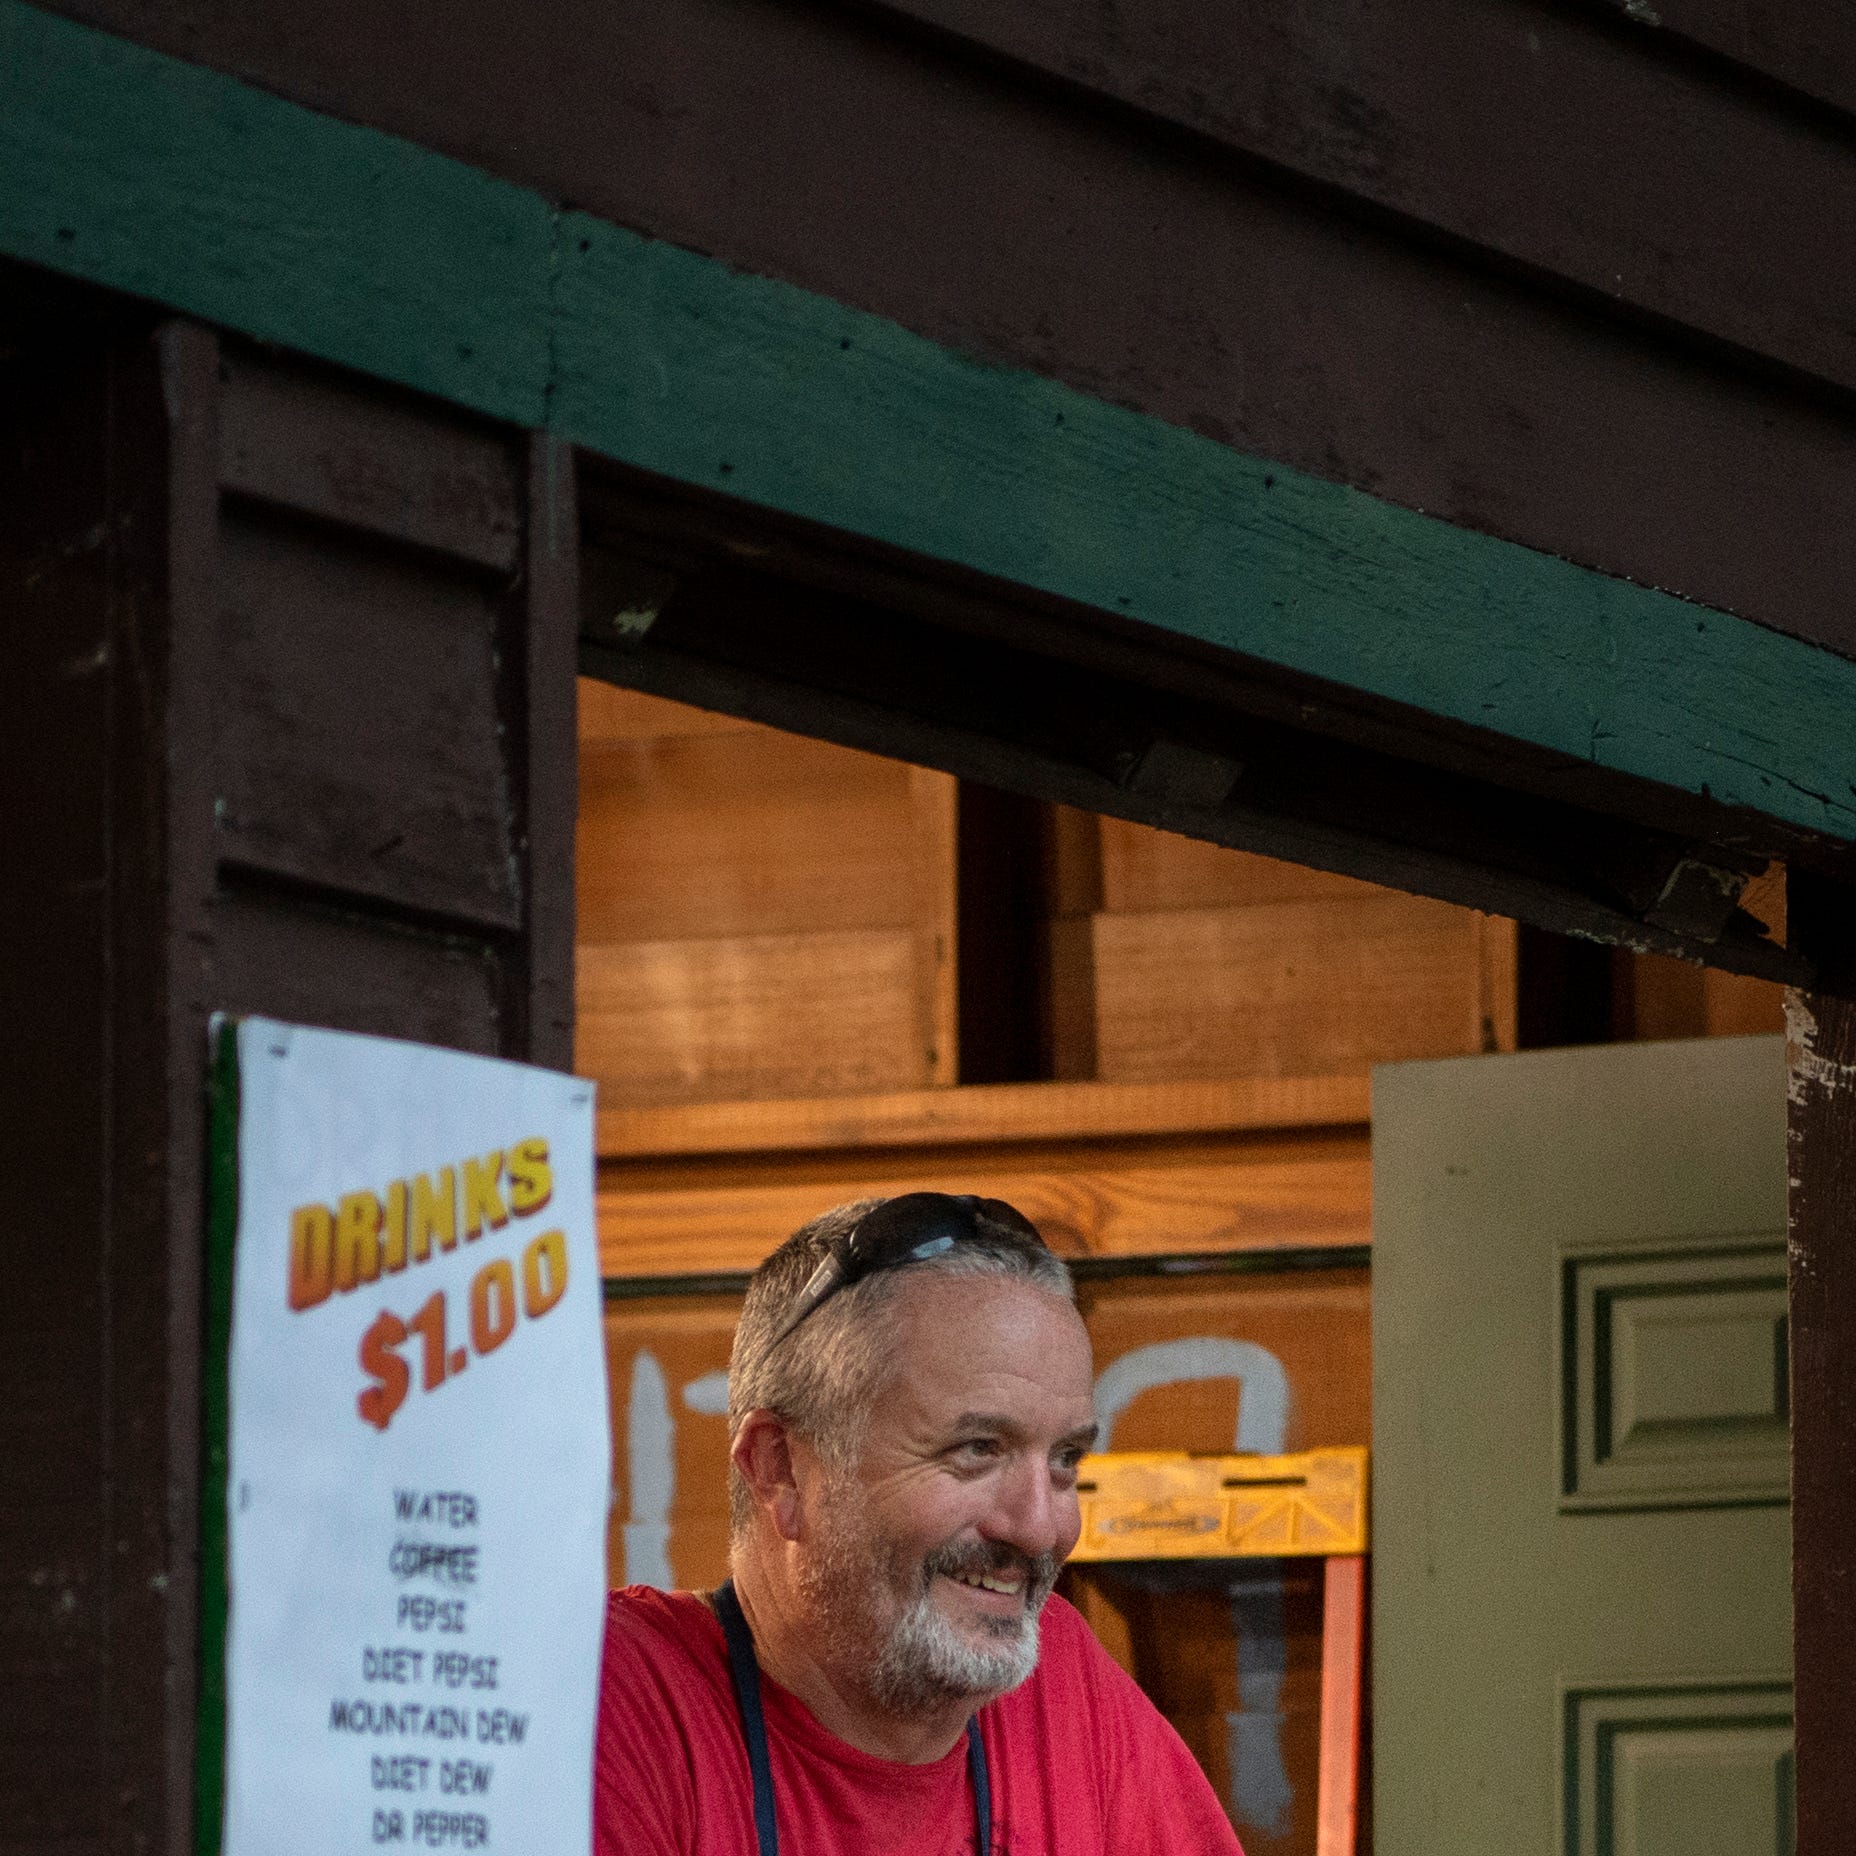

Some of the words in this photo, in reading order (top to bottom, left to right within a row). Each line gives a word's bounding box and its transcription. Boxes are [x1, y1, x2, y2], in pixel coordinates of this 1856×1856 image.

[287, 1136, 553, 1312] DRINKS
[357, 1228, 570, 1432] $1.00
[394, 1489, 478, 1528] WATER
[389, 1542, 479, 1585] COFFEE
[397, 1594, 465, 1634] PEPSI
[362, 1646, 423, 1684] DIET
[433, 1652, 498, 1690] PEPSI
[330, 1700, 469, 1740] MOUNTAIN
[476, 1708, 528, 1744] DEW
[371, 1755, 430, 1792] DIET
[440, 1760, 492, 1796] DEW
[372, 1809, 403, 1844] DR
[413, 1811, 489, 1849] PEPPER
